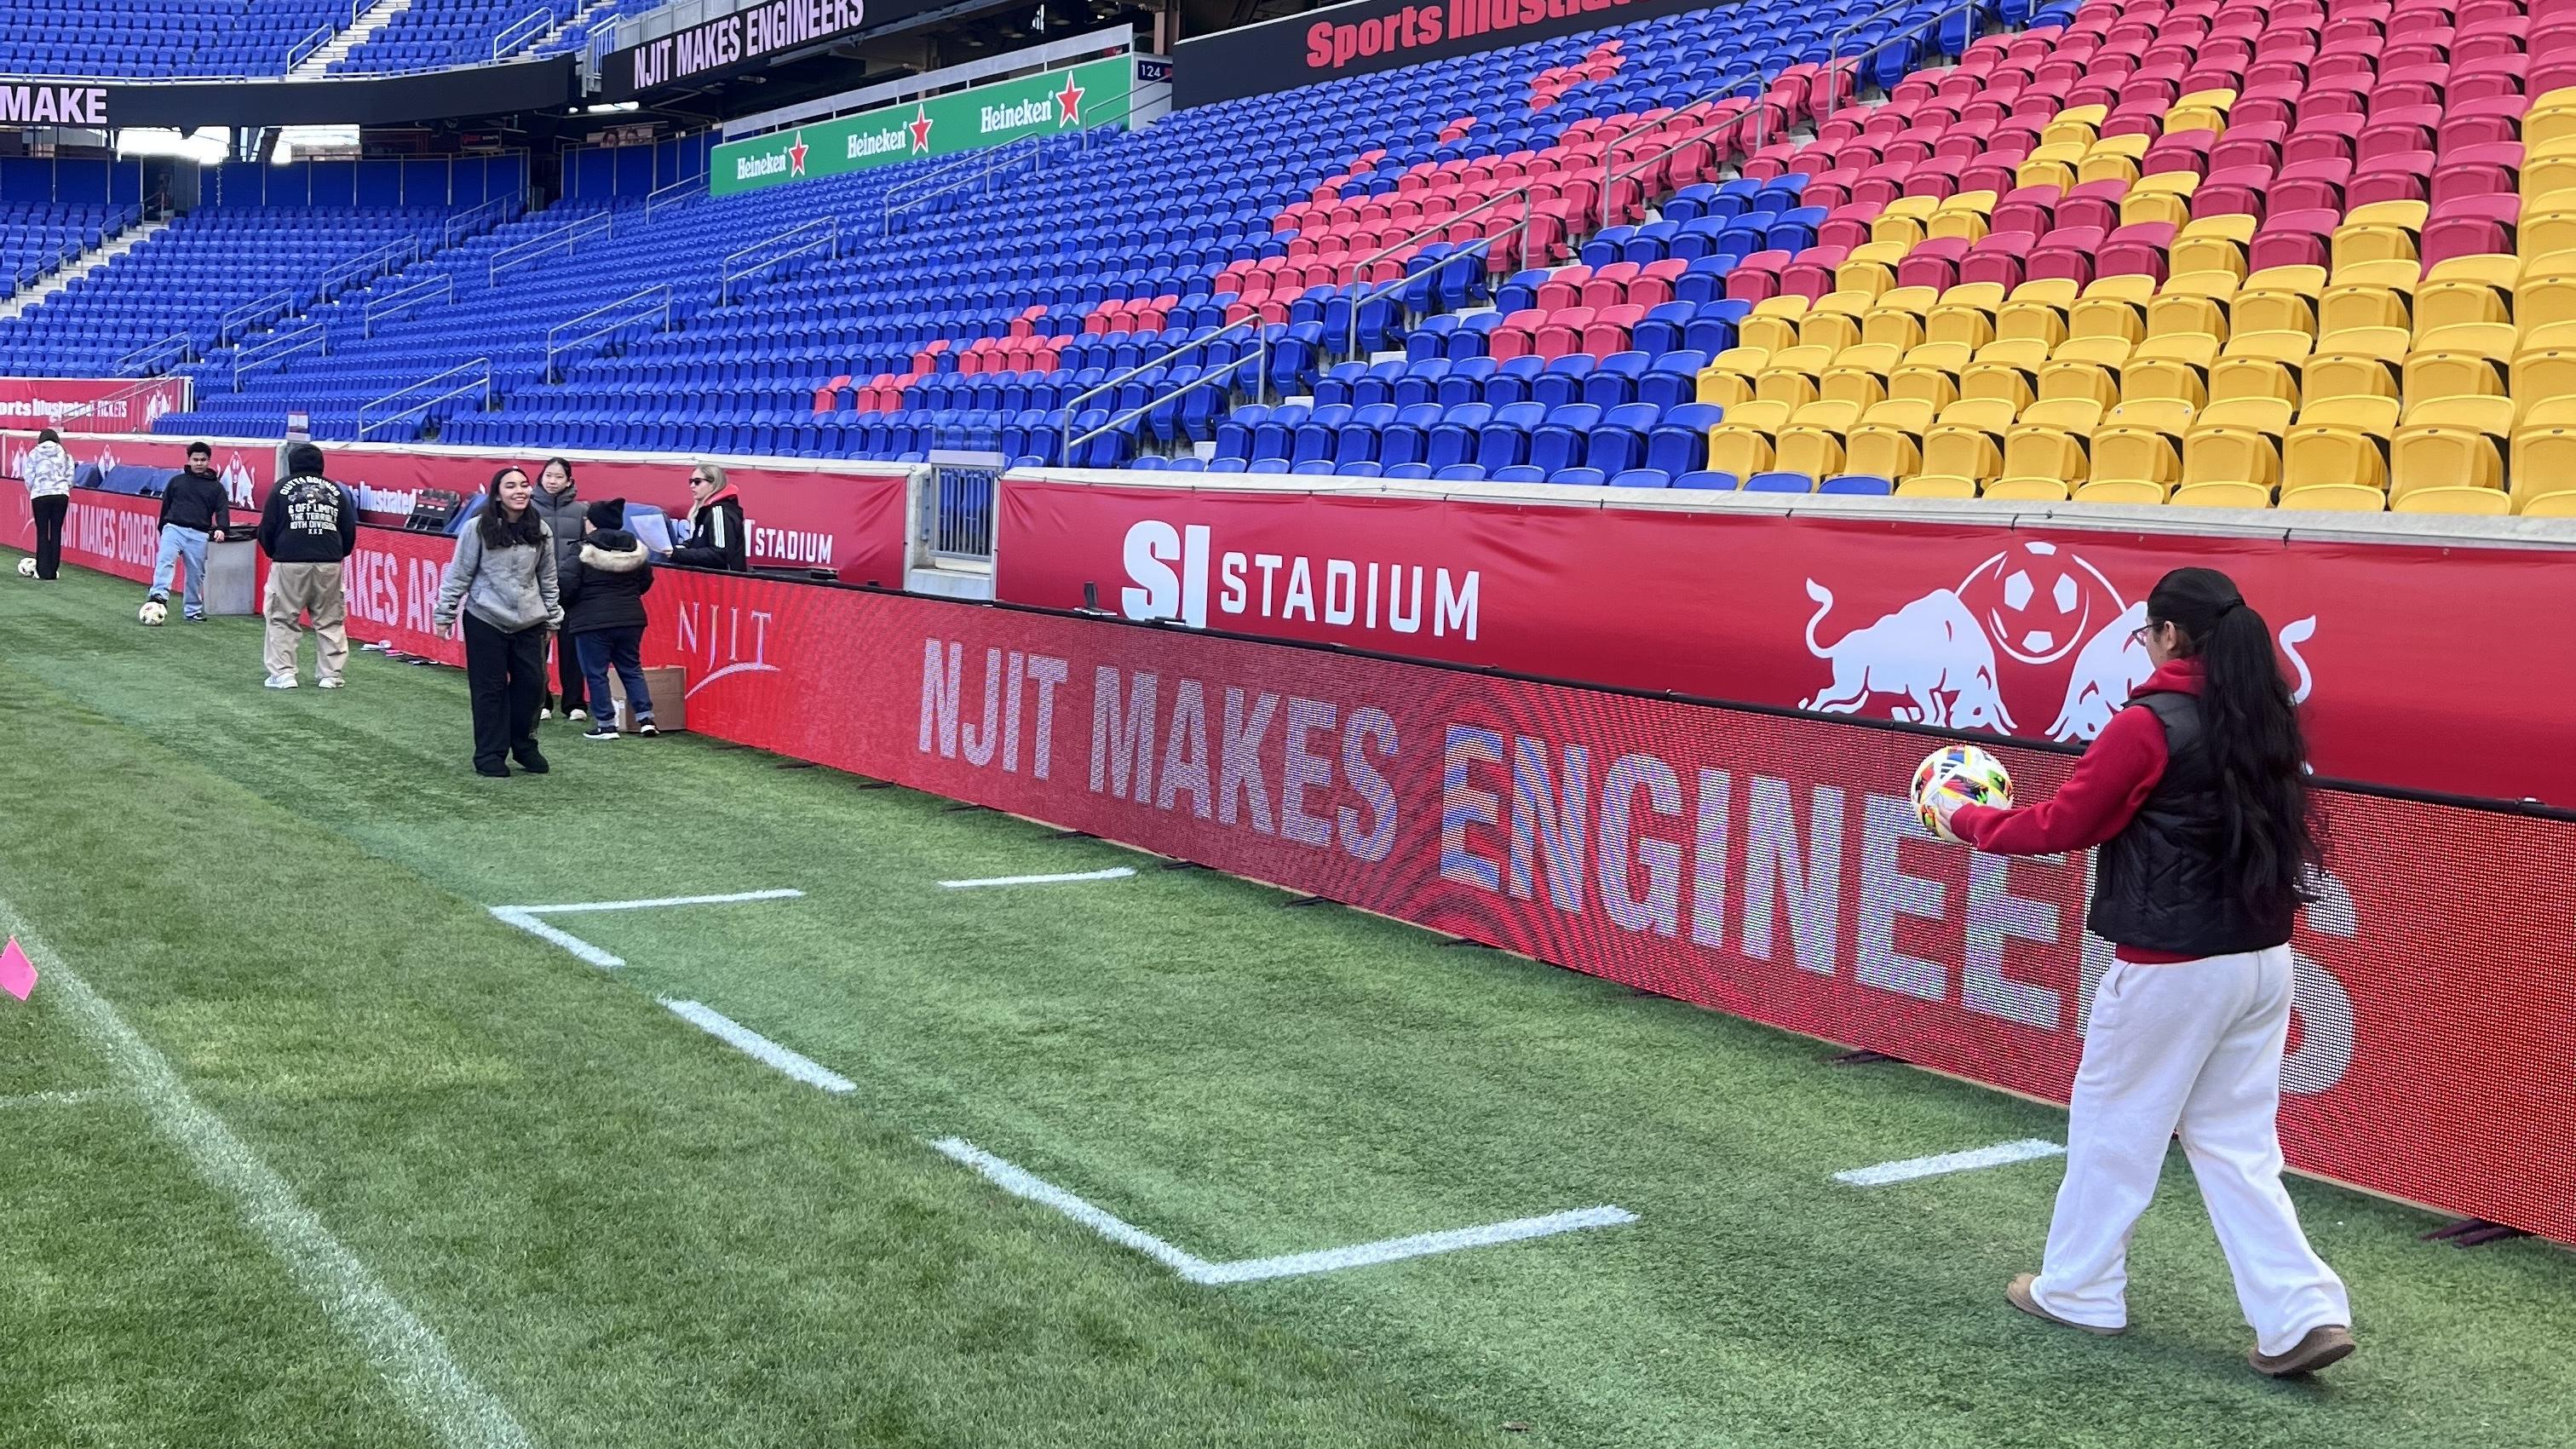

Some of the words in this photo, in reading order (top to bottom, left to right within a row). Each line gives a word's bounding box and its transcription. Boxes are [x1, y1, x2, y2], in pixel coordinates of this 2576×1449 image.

[634, 38, 671, 89] NJIT
[676, 15, 740, 78] MAKES
[746, 0, 864, 57] ENGINEERS
[1306, 5, 1442, 68] Sports
[1141, 65, 1160, 78] 124
[0, 85, 107, 124] MAKE
[980, 98, 1052, 134] Heineken
[847, 129, 906, 159] Heineken
[737, 153, 786, 180] Heineken
[0, 400, 32, 417] orts
[296, 503, 313, 513] OFF
[359, 480, 417, 515] Illustrated
[290, 513, 304, 521] THE
[79, 503, 116, 559] MAKES
[118, 510, 160, 569] CODER
[755, 527, 833, 564] STADIUM
[342, 548, 399, 627] AKES
[1122, 520, 1210, 629] SI
[1221, 552, 1481, 641] STADIUM
[677, 600, 772, 672] NJIT
[919, 639, 1068, 780] NJIT
[1090, 666, 1399, 863] MAKES
[1440, 723, 2357, 1094] ENGINEES
